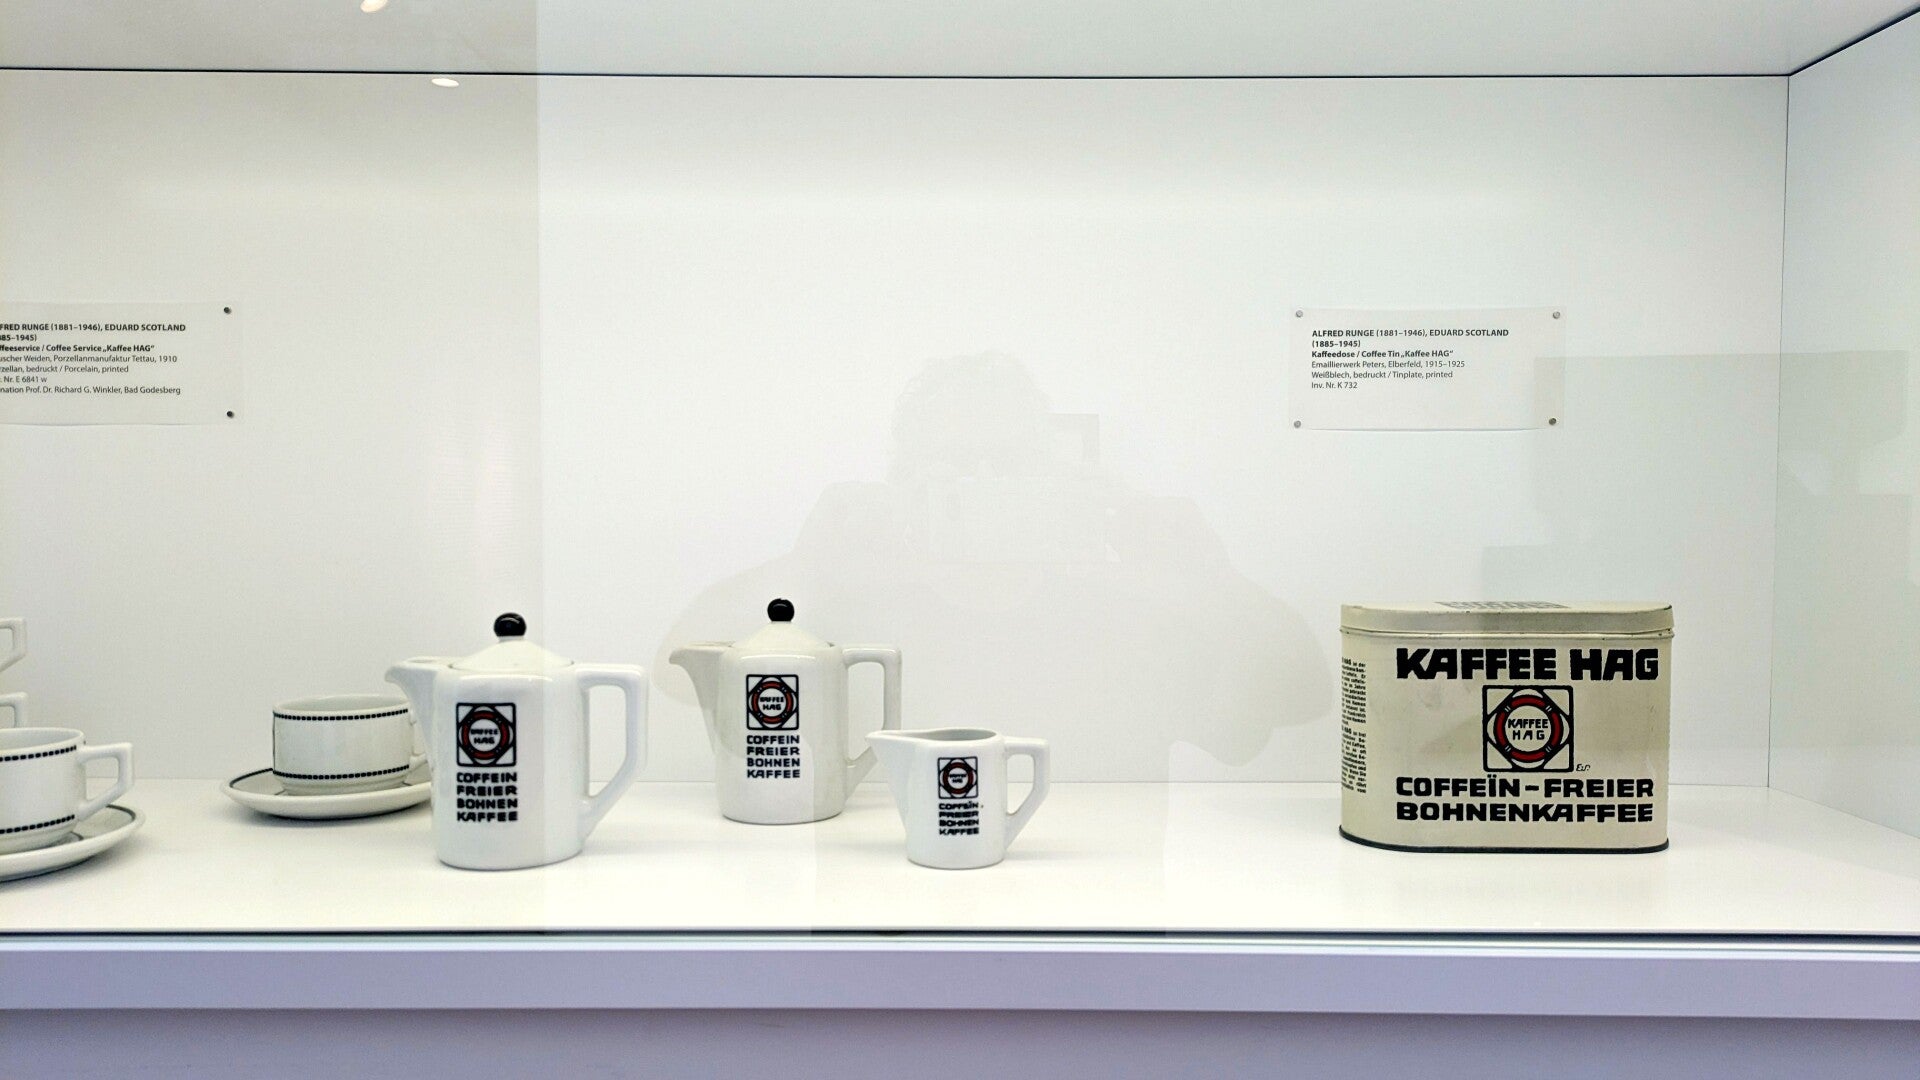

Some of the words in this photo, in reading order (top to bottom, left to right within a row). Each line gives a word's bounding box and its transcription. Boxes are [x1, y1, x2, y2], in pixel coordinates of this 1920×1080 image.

[1377, 329, 1427, 337] (1881–1946),
[1312, 340, 1360, 348] (1885–1945)
[65, 365, 100, 373] Porcelain,
[1312, 371, 1351, 379] Weißblech,
[1393, 371, 1423, 379] Tinplate,
[1426, 371, 1452, 379] printed
[93, 386, 122, 394] Winkler,
[140, 387, 180, 395] Godesberg
[1396, 648, 1556, 680] KAFFEE
[1570, 649, 1658, 681] HAG
[1507, 718, 1549, 729] KAFFEE
[1513, 730, 1545, 740] HAG
[747, 746, 799, 756] FREIER
[747, 758, 800, 767] BOHNEN
[747, 769, 800, 778] KAFFEE
[457, 785, 517, 796] FREIER
[457, 798, 517, 809] BOHNEN
[457, 811, 517, 822] KAFFEE
[1397, 802, 1653, 822] BOHNENKAFFEE
